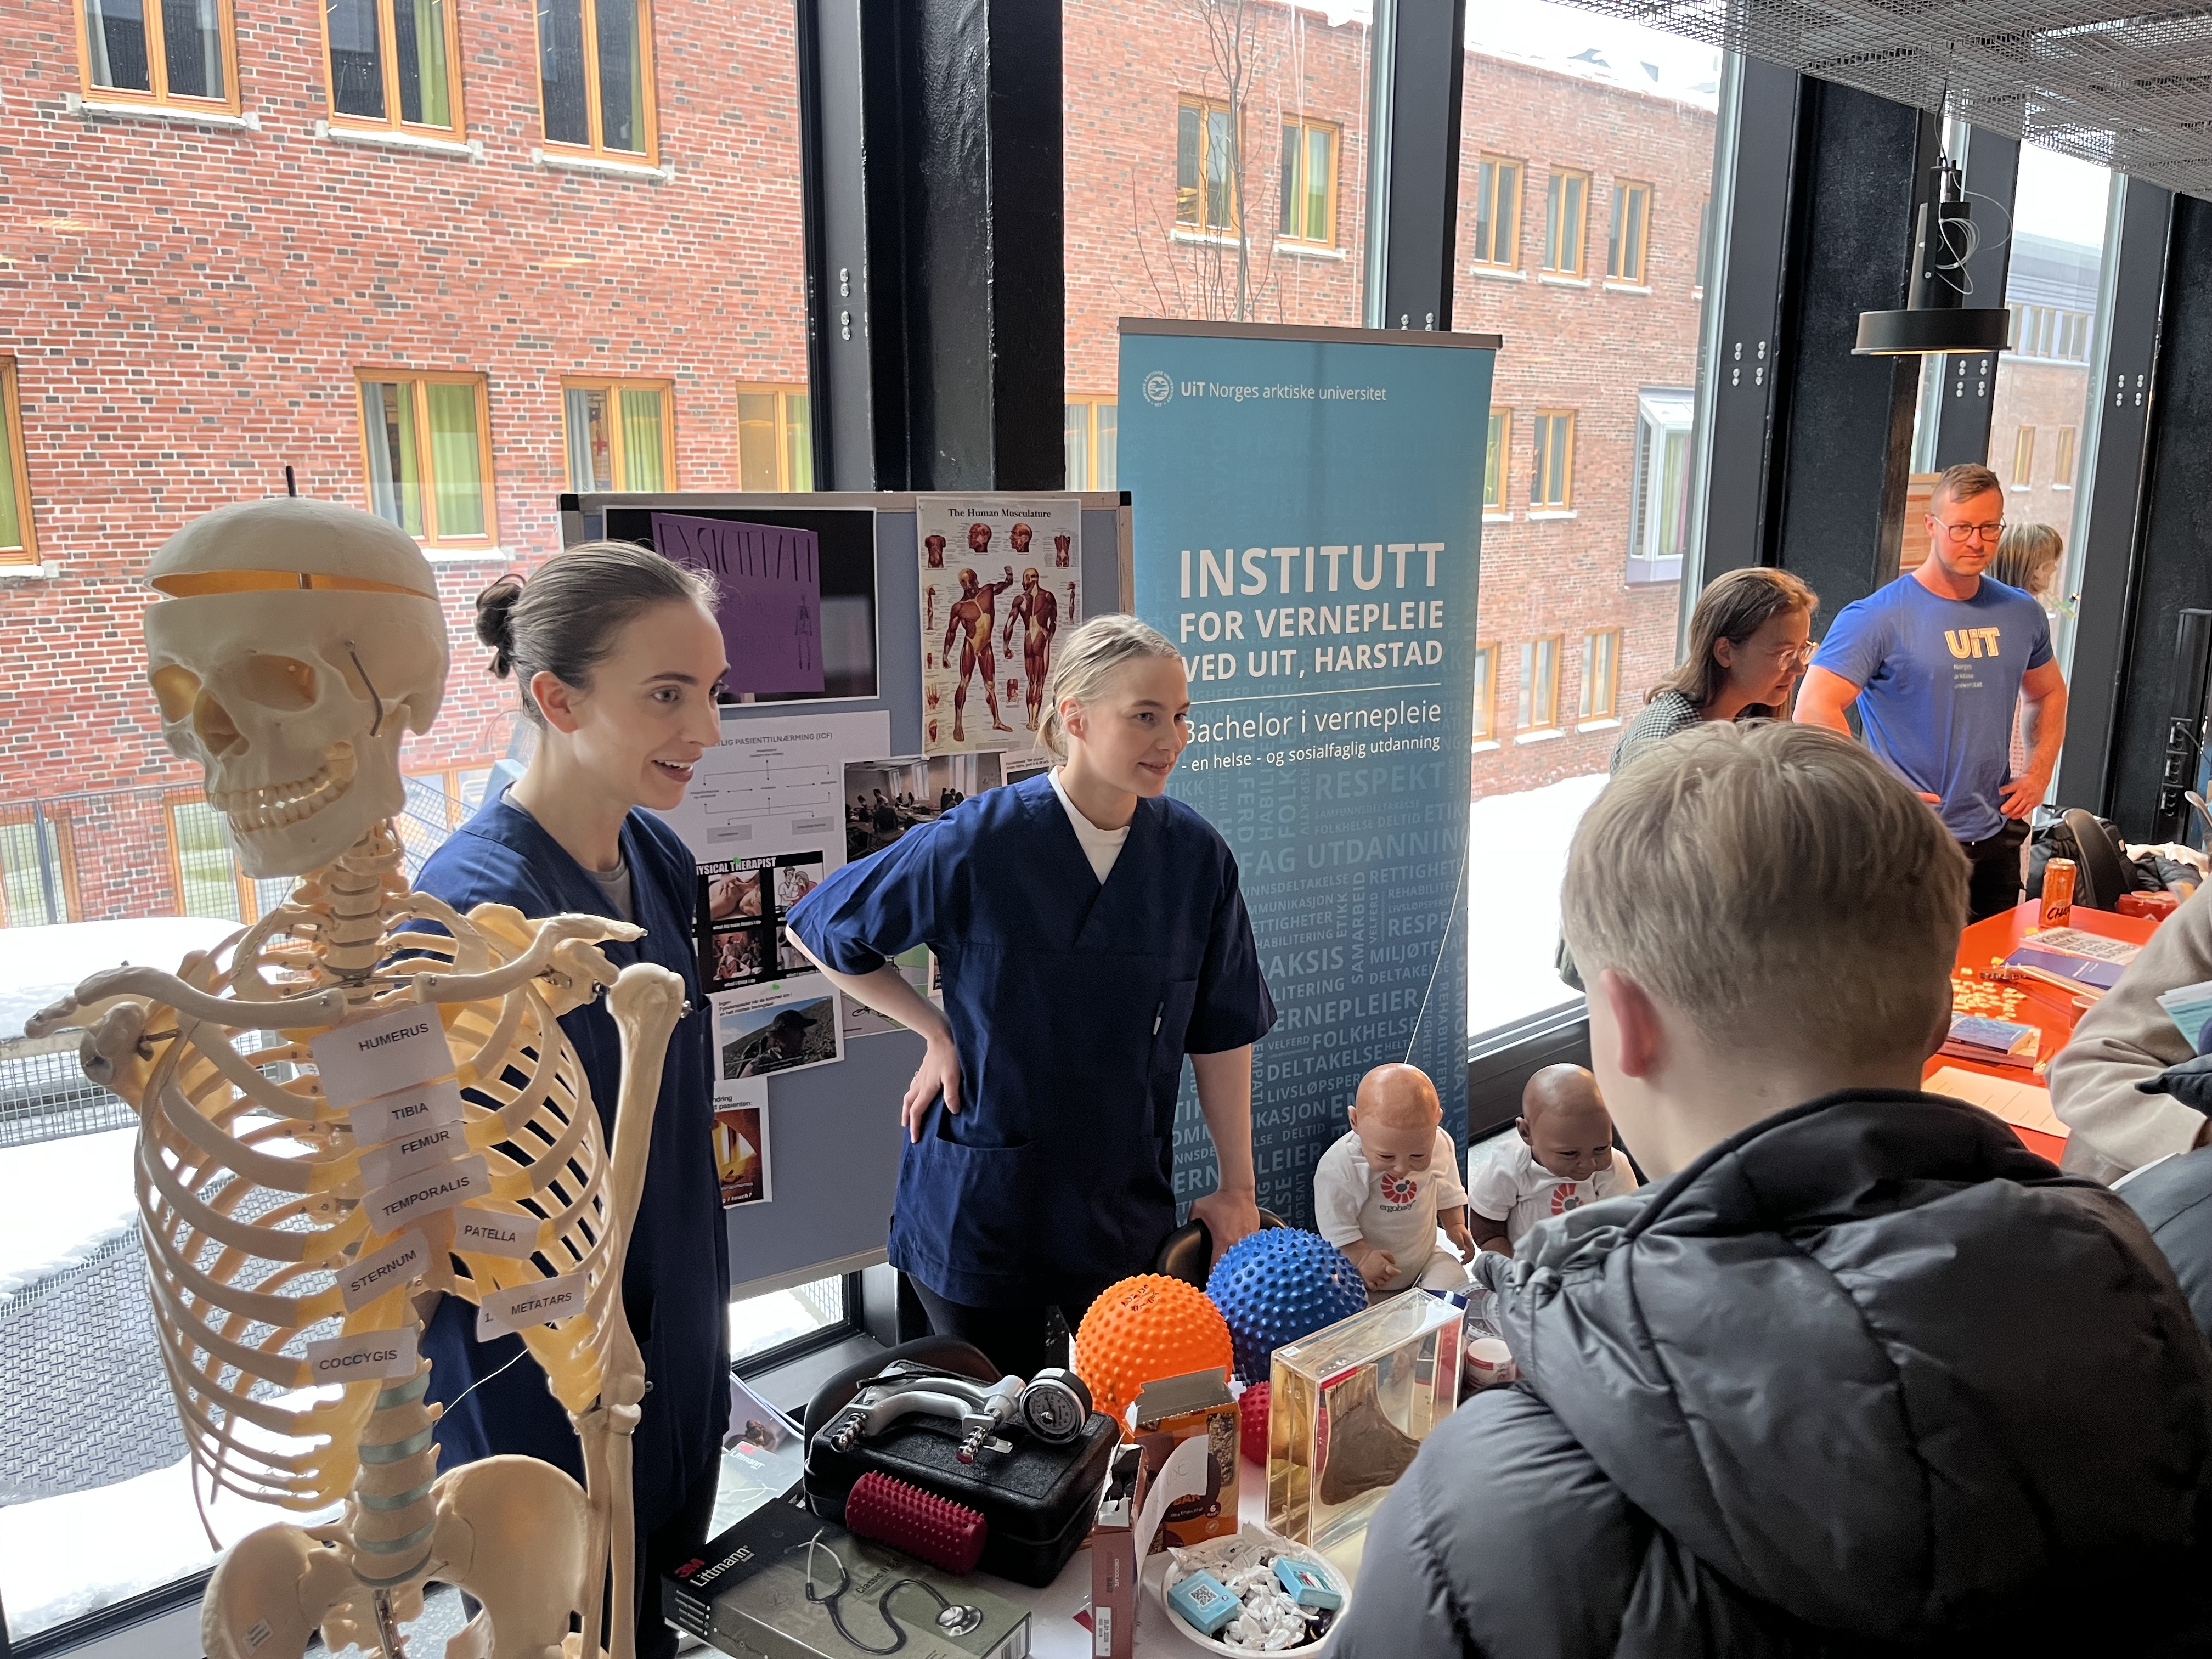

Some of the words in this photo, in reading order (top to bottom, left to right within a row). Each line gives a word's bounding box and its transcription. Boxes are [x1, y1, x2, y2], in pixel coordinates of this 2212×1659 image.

[1181, 381, 1205, 397] UiT
[1209, 382, 1259, 402] Norges
[1263, 383, 1315, 400] arktiske
[1319, 386, 1387, 401] universitet
[948, 509, 964, 517] The
[967, 509, 999, 517] Human
[1002, 509, 1051, 518] Musculature
[1181, 542, 1444, 599] INSTITUTT
[1181, 611, 1245, 644] FOR
[1255, 600, 1443, 639] VERNEPLEIE
[1182, 653, 1237, 683] VED
[1248, 649, 1306, 679] UIT,
[1315, 640, 1443, 674] HARSTAD
[1186, 711, 1293, 745] Bachelor
[1301, 709, 1307, 734] i
[1315, 699, 1441, 734] vernepleie
[735, 733, 815, 745] PASIENTTILNÆRMING
[816, 732, 833, 741] (ICF)
[1191, 758, 1210, 772] en
[1213, 750, 1252, 769] helse
[1266, 750, 1285, 768] og
[1288, 738, 1367, 762] sosialfaglig
[1369, 734, 1441, 754] utdanning
[1316, 761, 1445, 801] RESPEKT
[1378, 812, 1420, 828] DELTID
[696, 862, 729, 876] YSICAL
[730, 857, 776, 872] THERAPIST
[1239, 847, 1296, 878] FAG
[1370, 858, 1462, 884] RETTIGHETE
[1242, 873, 1349, 898] UNNSDELTAKELSE
[1248, 894, 1334, 915] MMUNIKASJON
[1251, 911, 1333, 933] ETTIGHETER
[1255, 929, 1333, 949] HABILITERING
[1272, 988, 1418, 1033] ERNEPLEIER
[358, 1023, 430, 1052] HUMERUS
[1267, 1035, 1310, 1051] VELFERD
[1267, 1043, 1384, 1082] DELTAKELSE
[1267, 1073, 1364, 1104] LIVSLØPSPER
[391, 1102, 429, 1121] TIBIA
[400, 1130, 451, 1155] FEMUR
[1282, 1122, 1326, 1142] DELTID
[382, 1176, 471, 1217] TEMPORALIS
[464, 1225, 517, 1243] PATELLA
[351, 1249, 417, 1293] STERNUM
[511, 1292, 573, 1316] METATARS
[319, 1349, 398, 1372] COCCYGIS
[690, 1547, 751, 1587] Littmann
[855, 1573, 884, 1593] Classic
